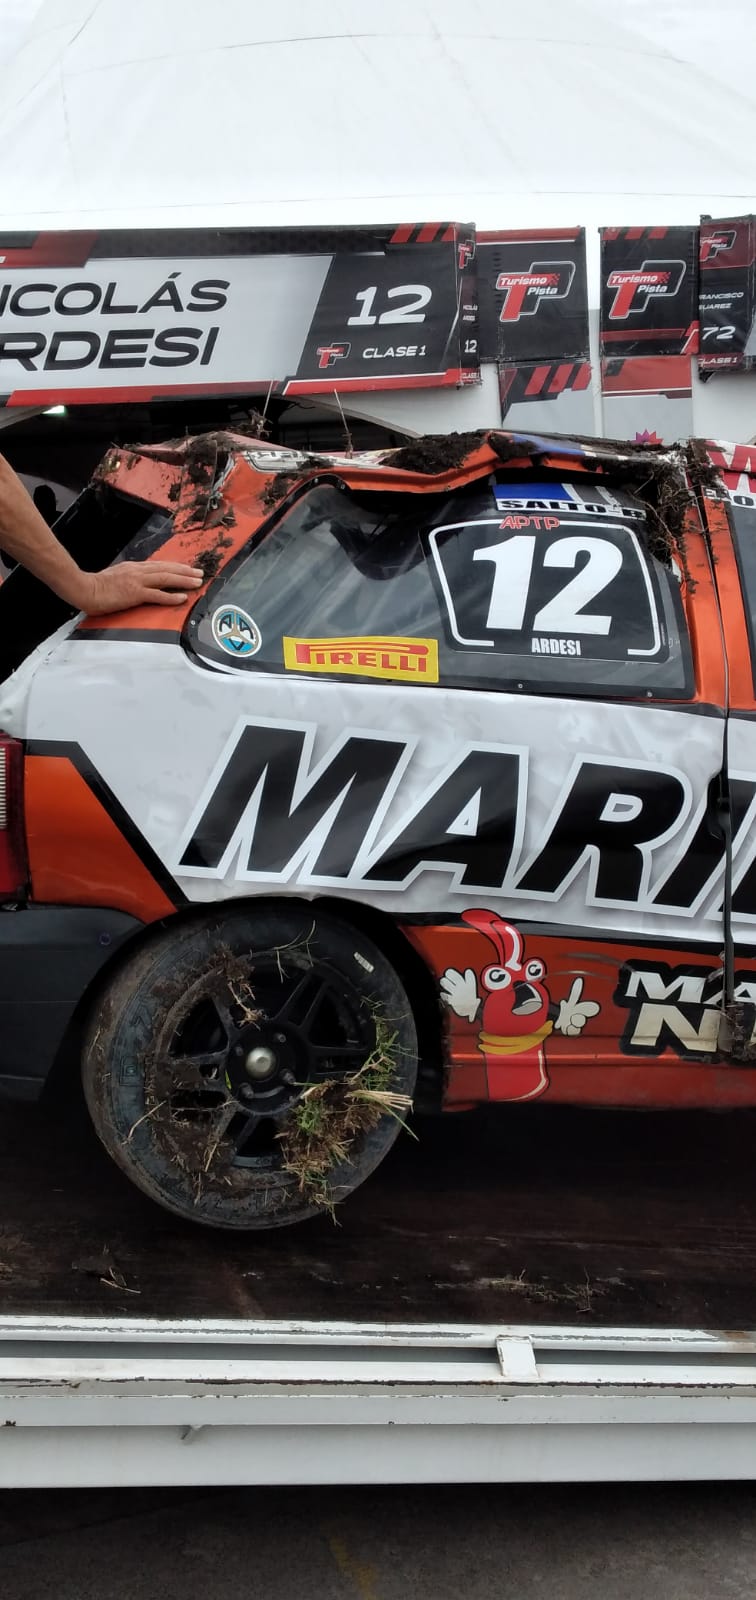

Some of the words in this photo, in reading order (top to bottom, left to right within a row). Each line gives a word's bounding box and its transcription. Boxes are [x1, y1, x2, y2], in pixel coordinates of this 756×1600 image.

[500, 276, 548, 286] Turismo
[611, 274, 658, 284] Turismo
[526, 286, 559, 296] Pista
[636, 284, 668, 293] Pista
[347, 284, 433, 326] 12
[702, 325, 736, 340] 72
[362, 346, 418, 359] CLASE
[418, 345, 427, 356] 1
[464, 339, 478, 353] 12
[472, 535, 623, 635] 12
[531, 637, 582, 656] ARDESI
[295, 641, 429, 673] PIRELLI
